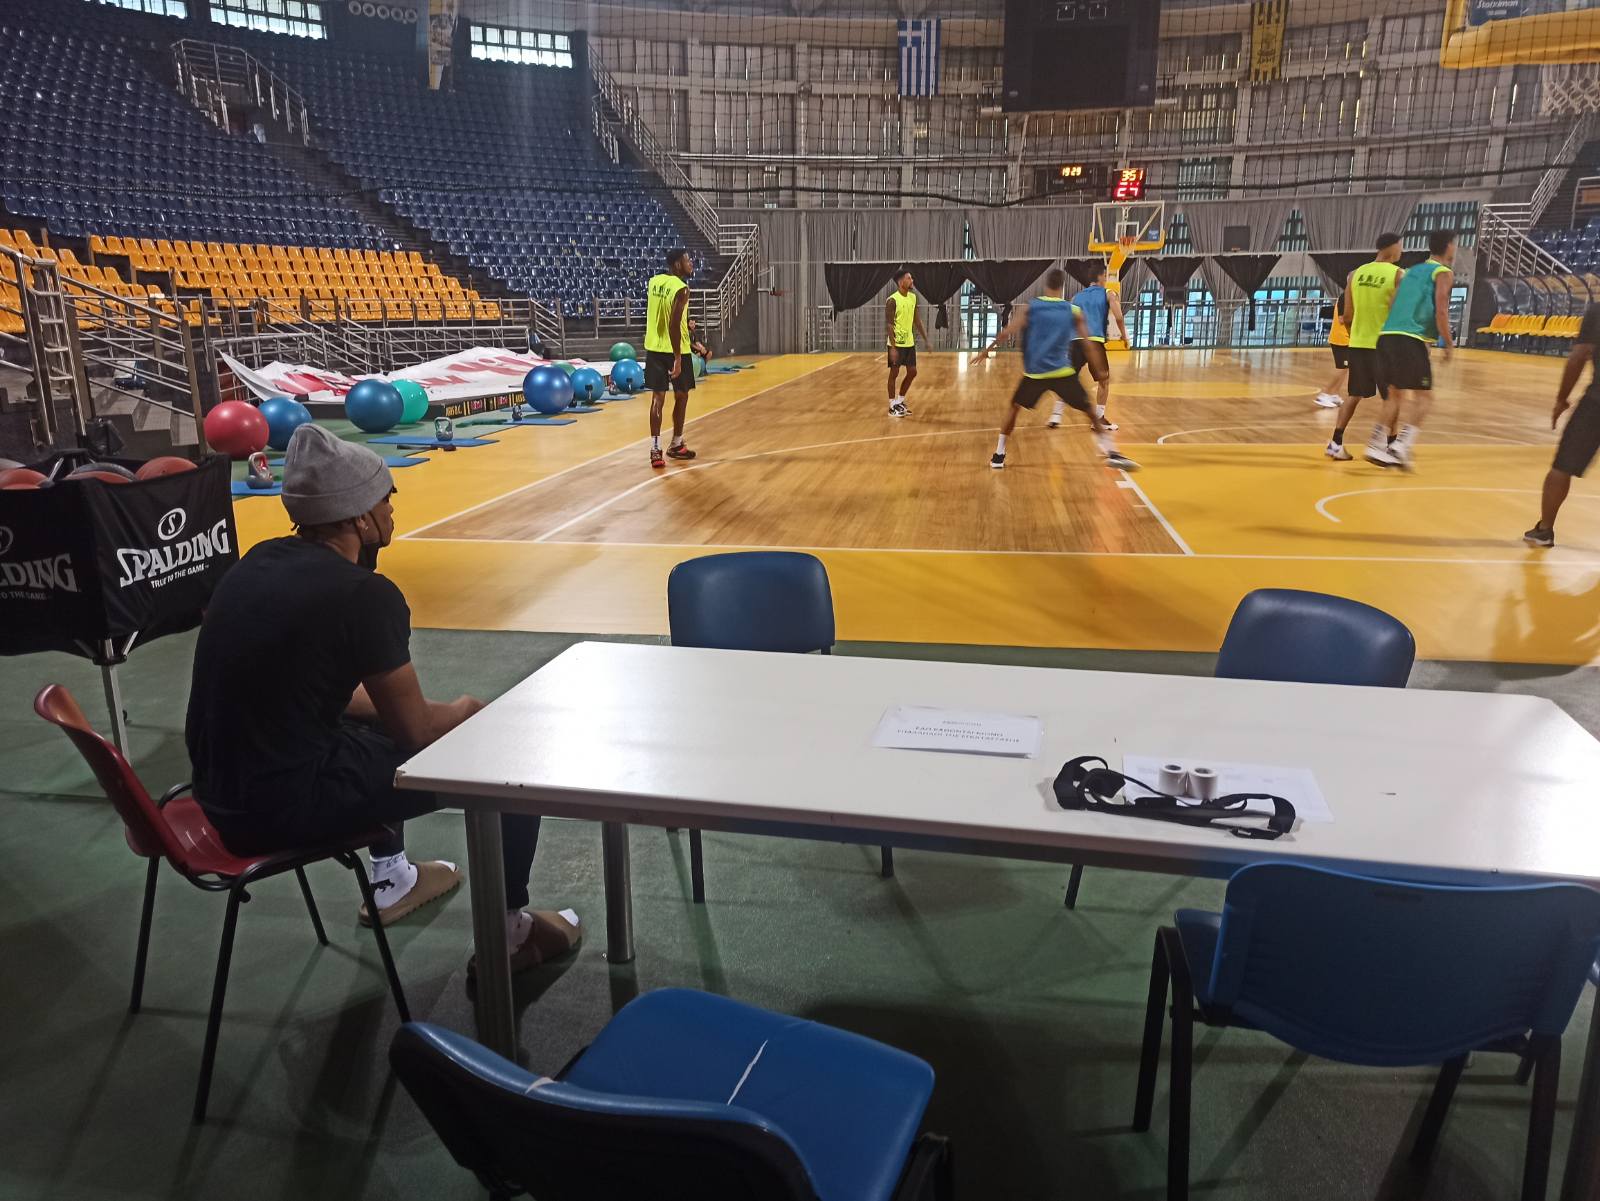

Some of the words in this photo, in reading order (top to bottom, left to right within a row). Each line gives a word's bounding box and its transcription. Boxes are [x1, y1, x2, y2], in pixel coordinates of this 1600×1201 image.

[0, 553, 78, 592] DING
[116, 518, 230, 588] SPALDING
[151, 576, 167, 589] TRUE
[174, 568, 187, 579] THE
[187, 563, 205, 576] GAME
